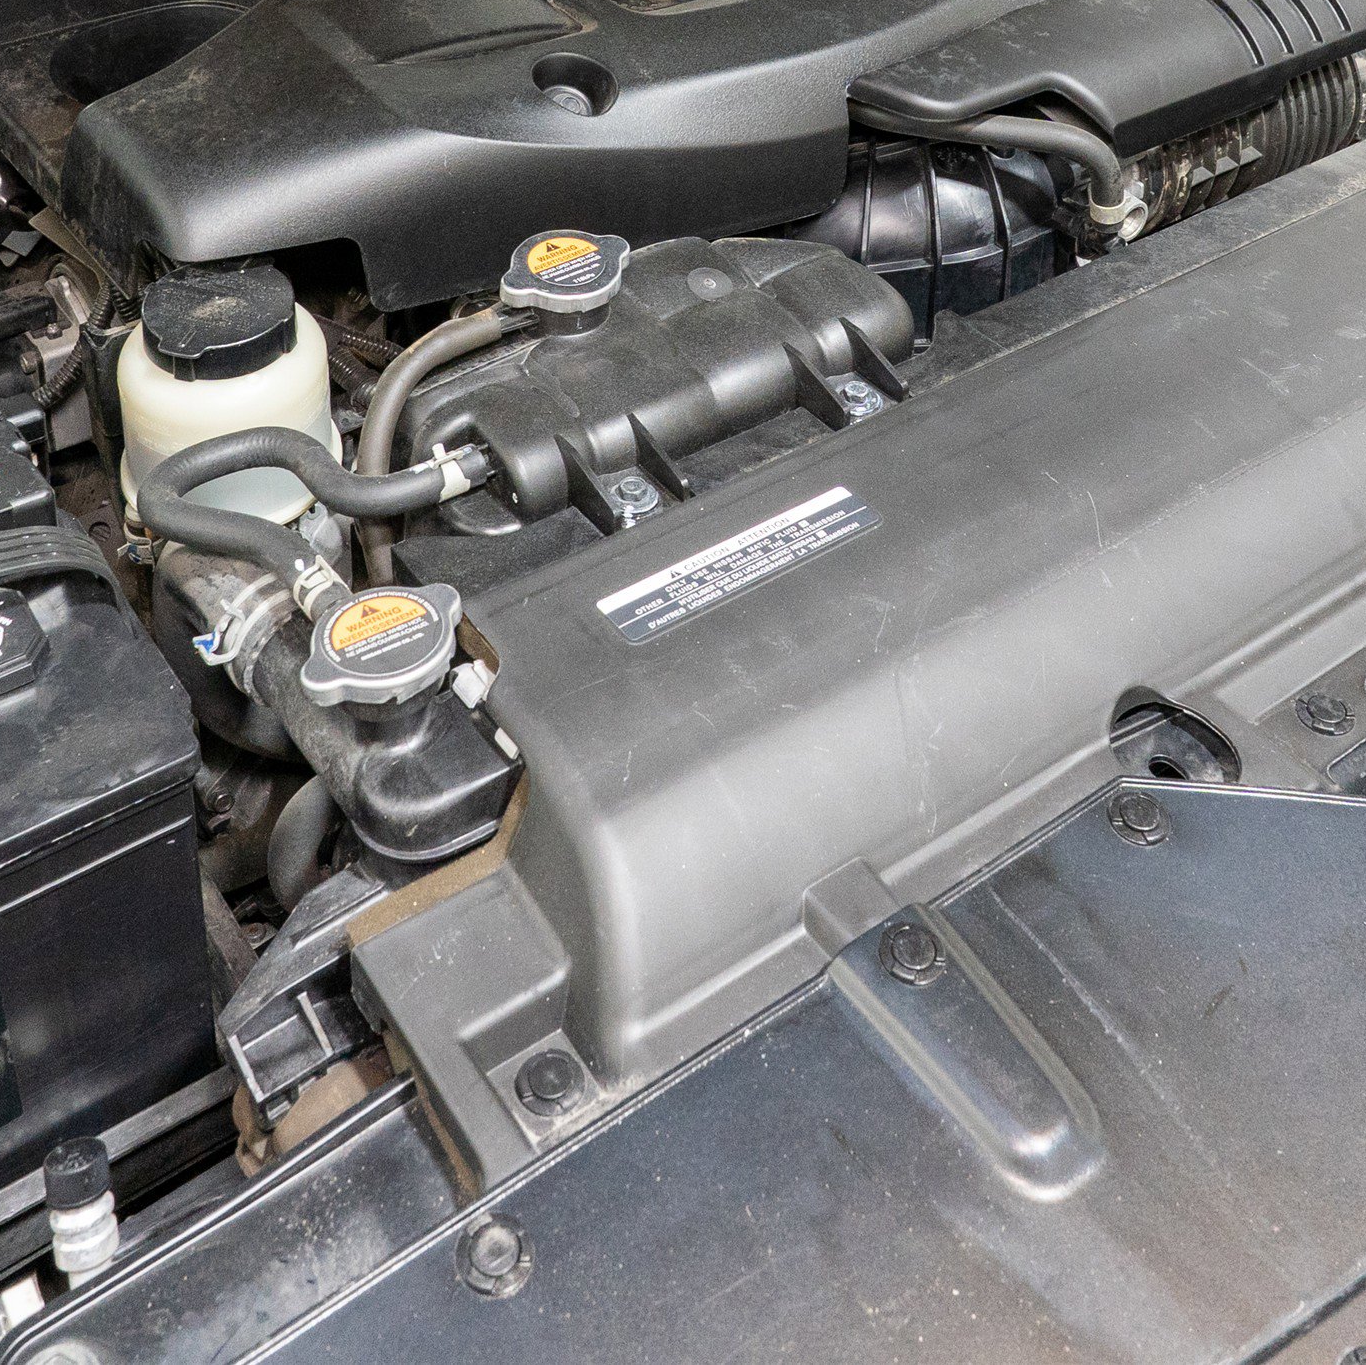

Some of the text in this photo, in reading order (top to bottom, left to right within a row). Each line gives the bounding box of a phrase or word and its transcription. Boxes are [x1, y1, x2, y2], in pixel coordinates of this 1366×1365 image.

[537, 244, 577, 262] WARNING
[665, 526, 797, 592] ONLY USE NISSAN MATIC FLUID
[684, 518, 789, 570] CAUTION ATTENTION
[635, 599, 663, 615] OTHER
[669, 581, 698, 598] FLUIDS
[704, 570, 725, 581] WILL
[730, 550, 764, 569] DAMAGE
[768, 539, 785, 549] THE
[687, 589, 722, 609] LIQUIDES
[796, 548, 808, 556] LA
[339, 608, 419, 645] AVERTISSEMENT
[346, 606, 401, 633] WARNING
